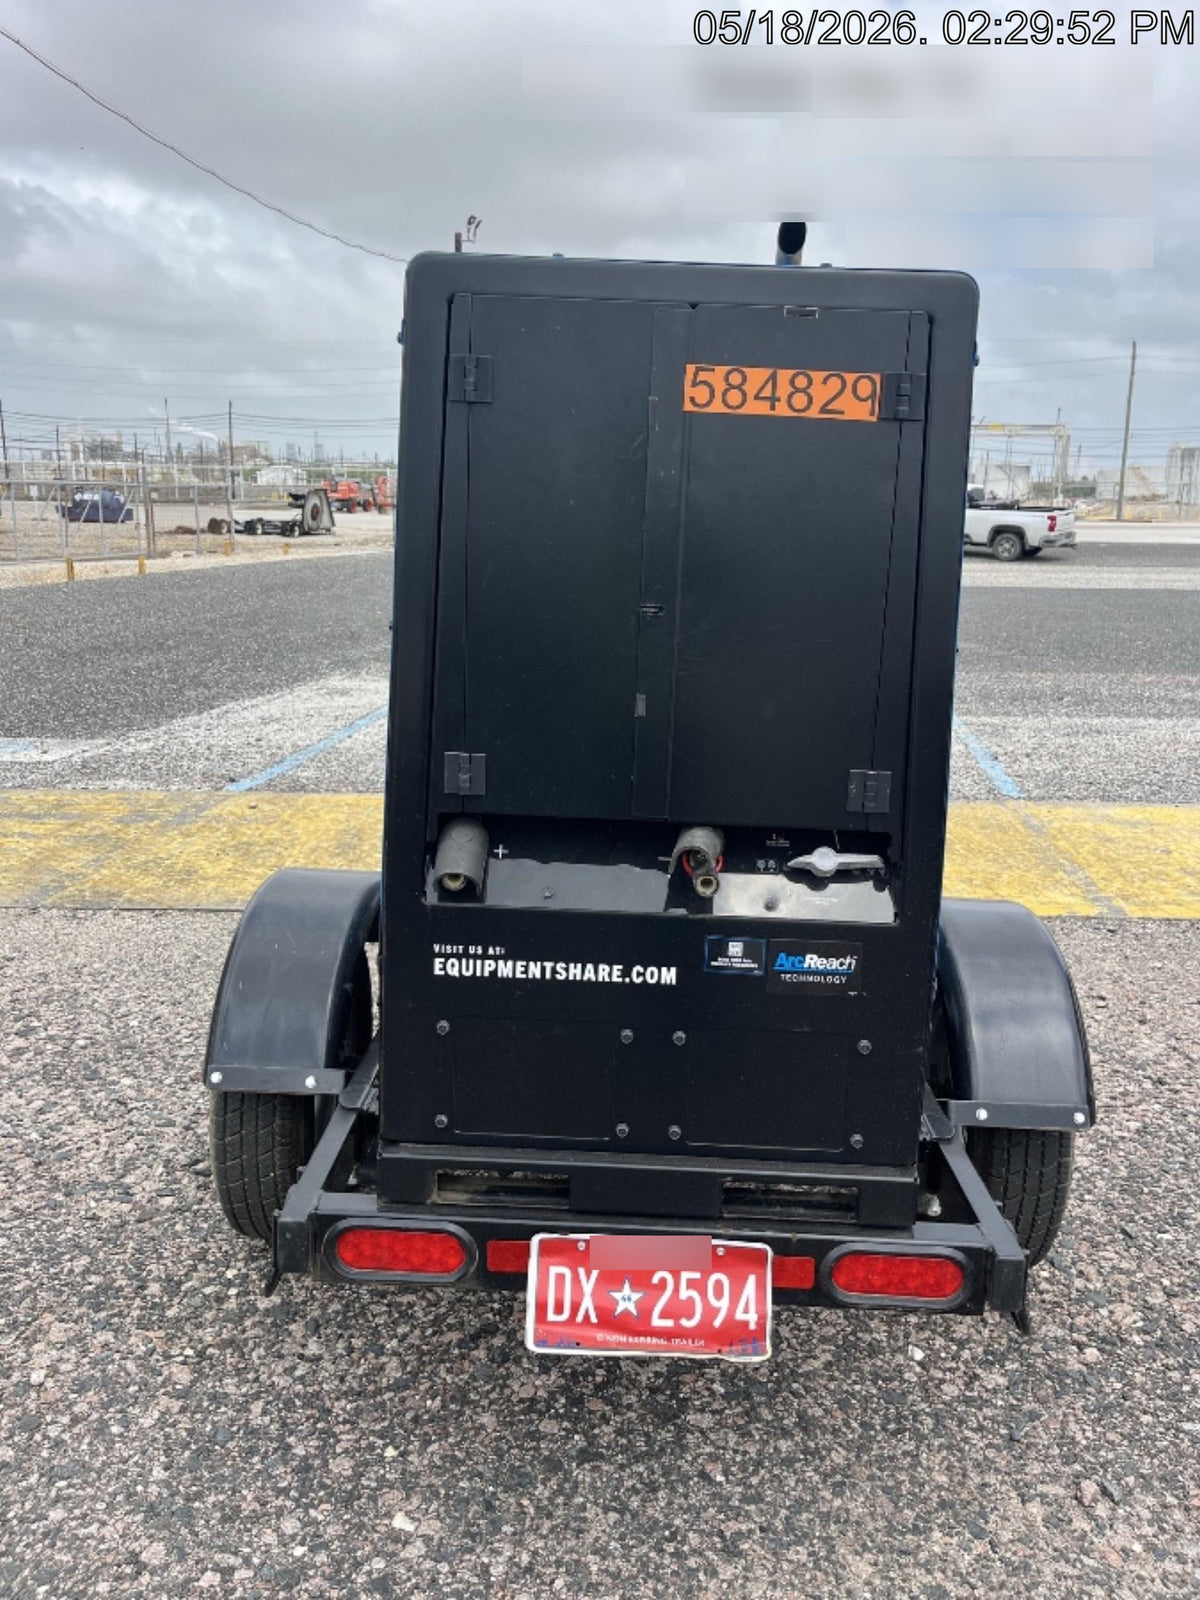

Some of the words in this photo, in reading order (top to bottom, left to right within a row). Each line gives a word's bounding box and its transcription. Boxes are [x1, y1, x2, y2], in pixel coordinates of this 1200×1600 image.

[689, 366, 877, 417] 584829
[433, 944, 464, 954] VISIT
[468, 945, 483, 955] US
[433, 957, 677, 985] EQUIPMENTSHARE.COM
[773, 952, 857, 971] ArcReach
[780, 973, 847, 984] TECHNOLOGY
[547, 1265, 599, 1323] DX
[651, 1270, 758, 1330] 2594
